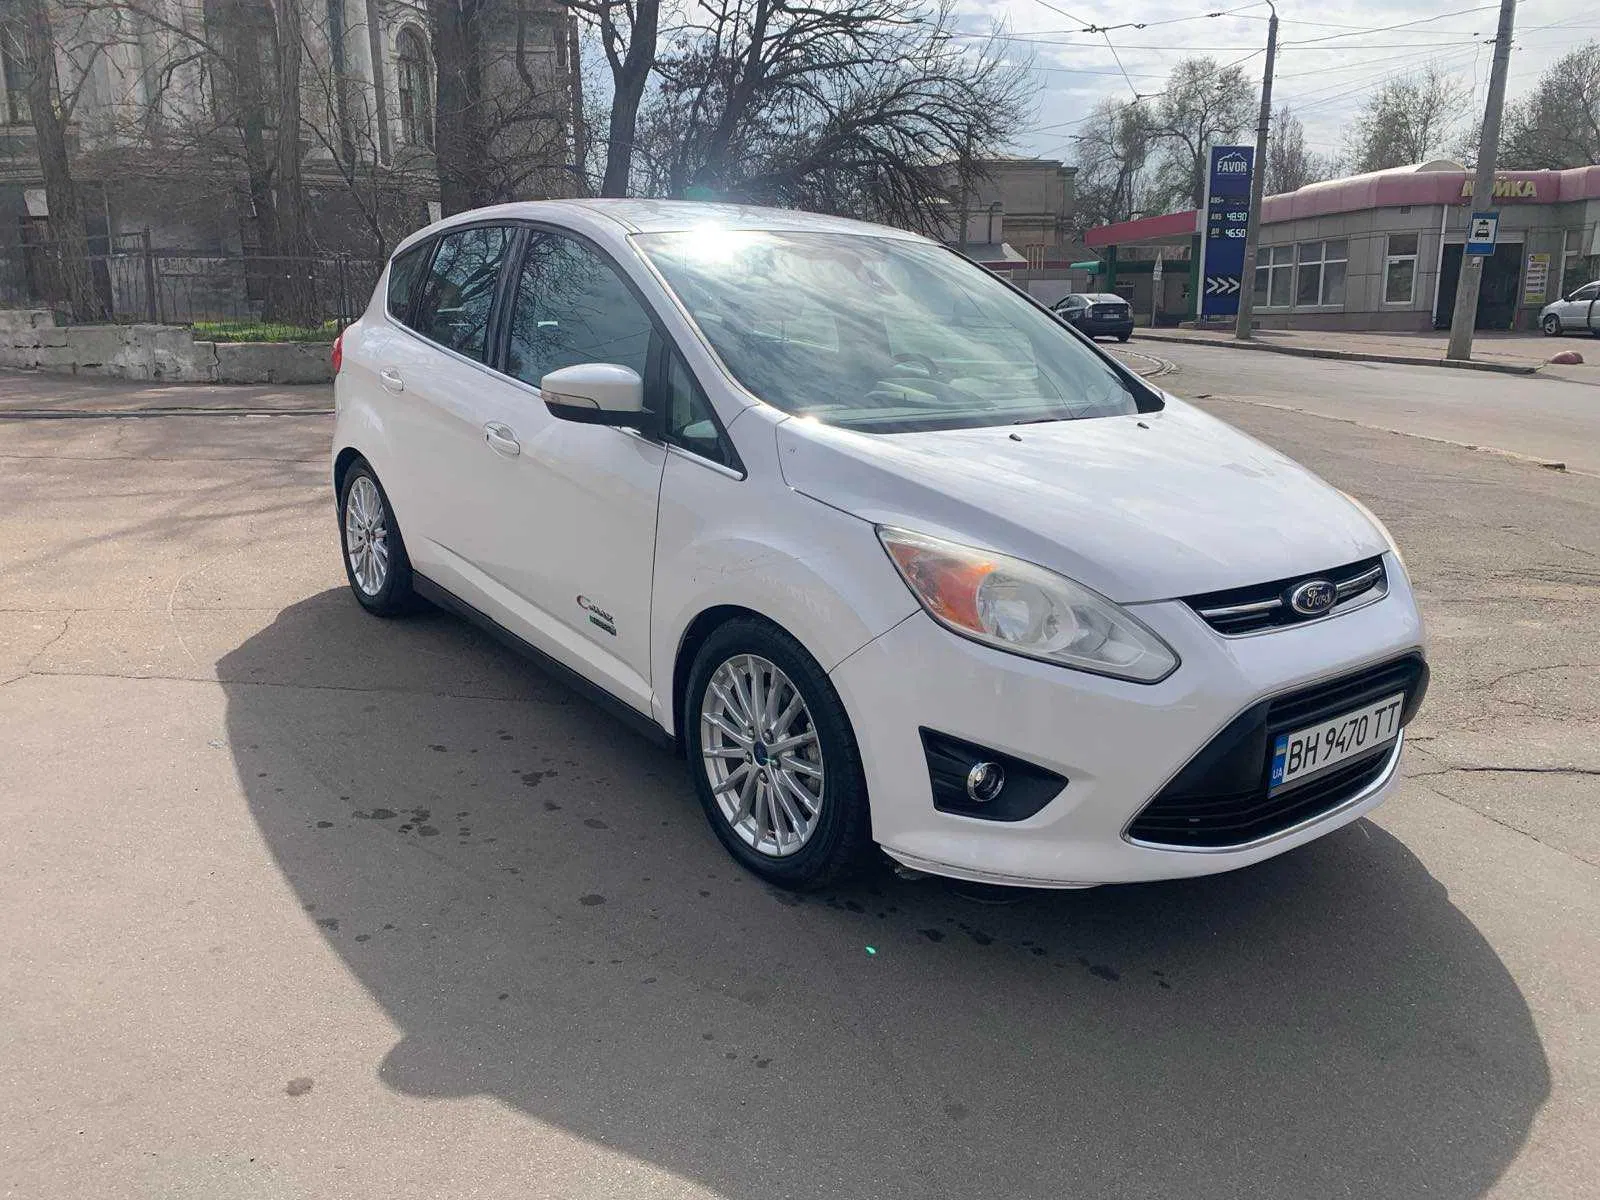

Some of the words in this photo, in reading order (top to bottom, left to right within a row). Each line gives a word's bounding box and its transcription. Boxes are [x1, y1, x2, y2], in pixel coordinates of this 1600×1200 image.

[1217, 161, 1247, 172] FAVOR
[1461, 177, 1537, 197] МЙКА
[1306, 586, 1331, 608] Ford
[1286, 732, 1321, 776] BH
[1323, 714, 1369, 761] 9470
[1374, 701, 1401, 739] TT
[1272, 768, 1284, 780] UA
